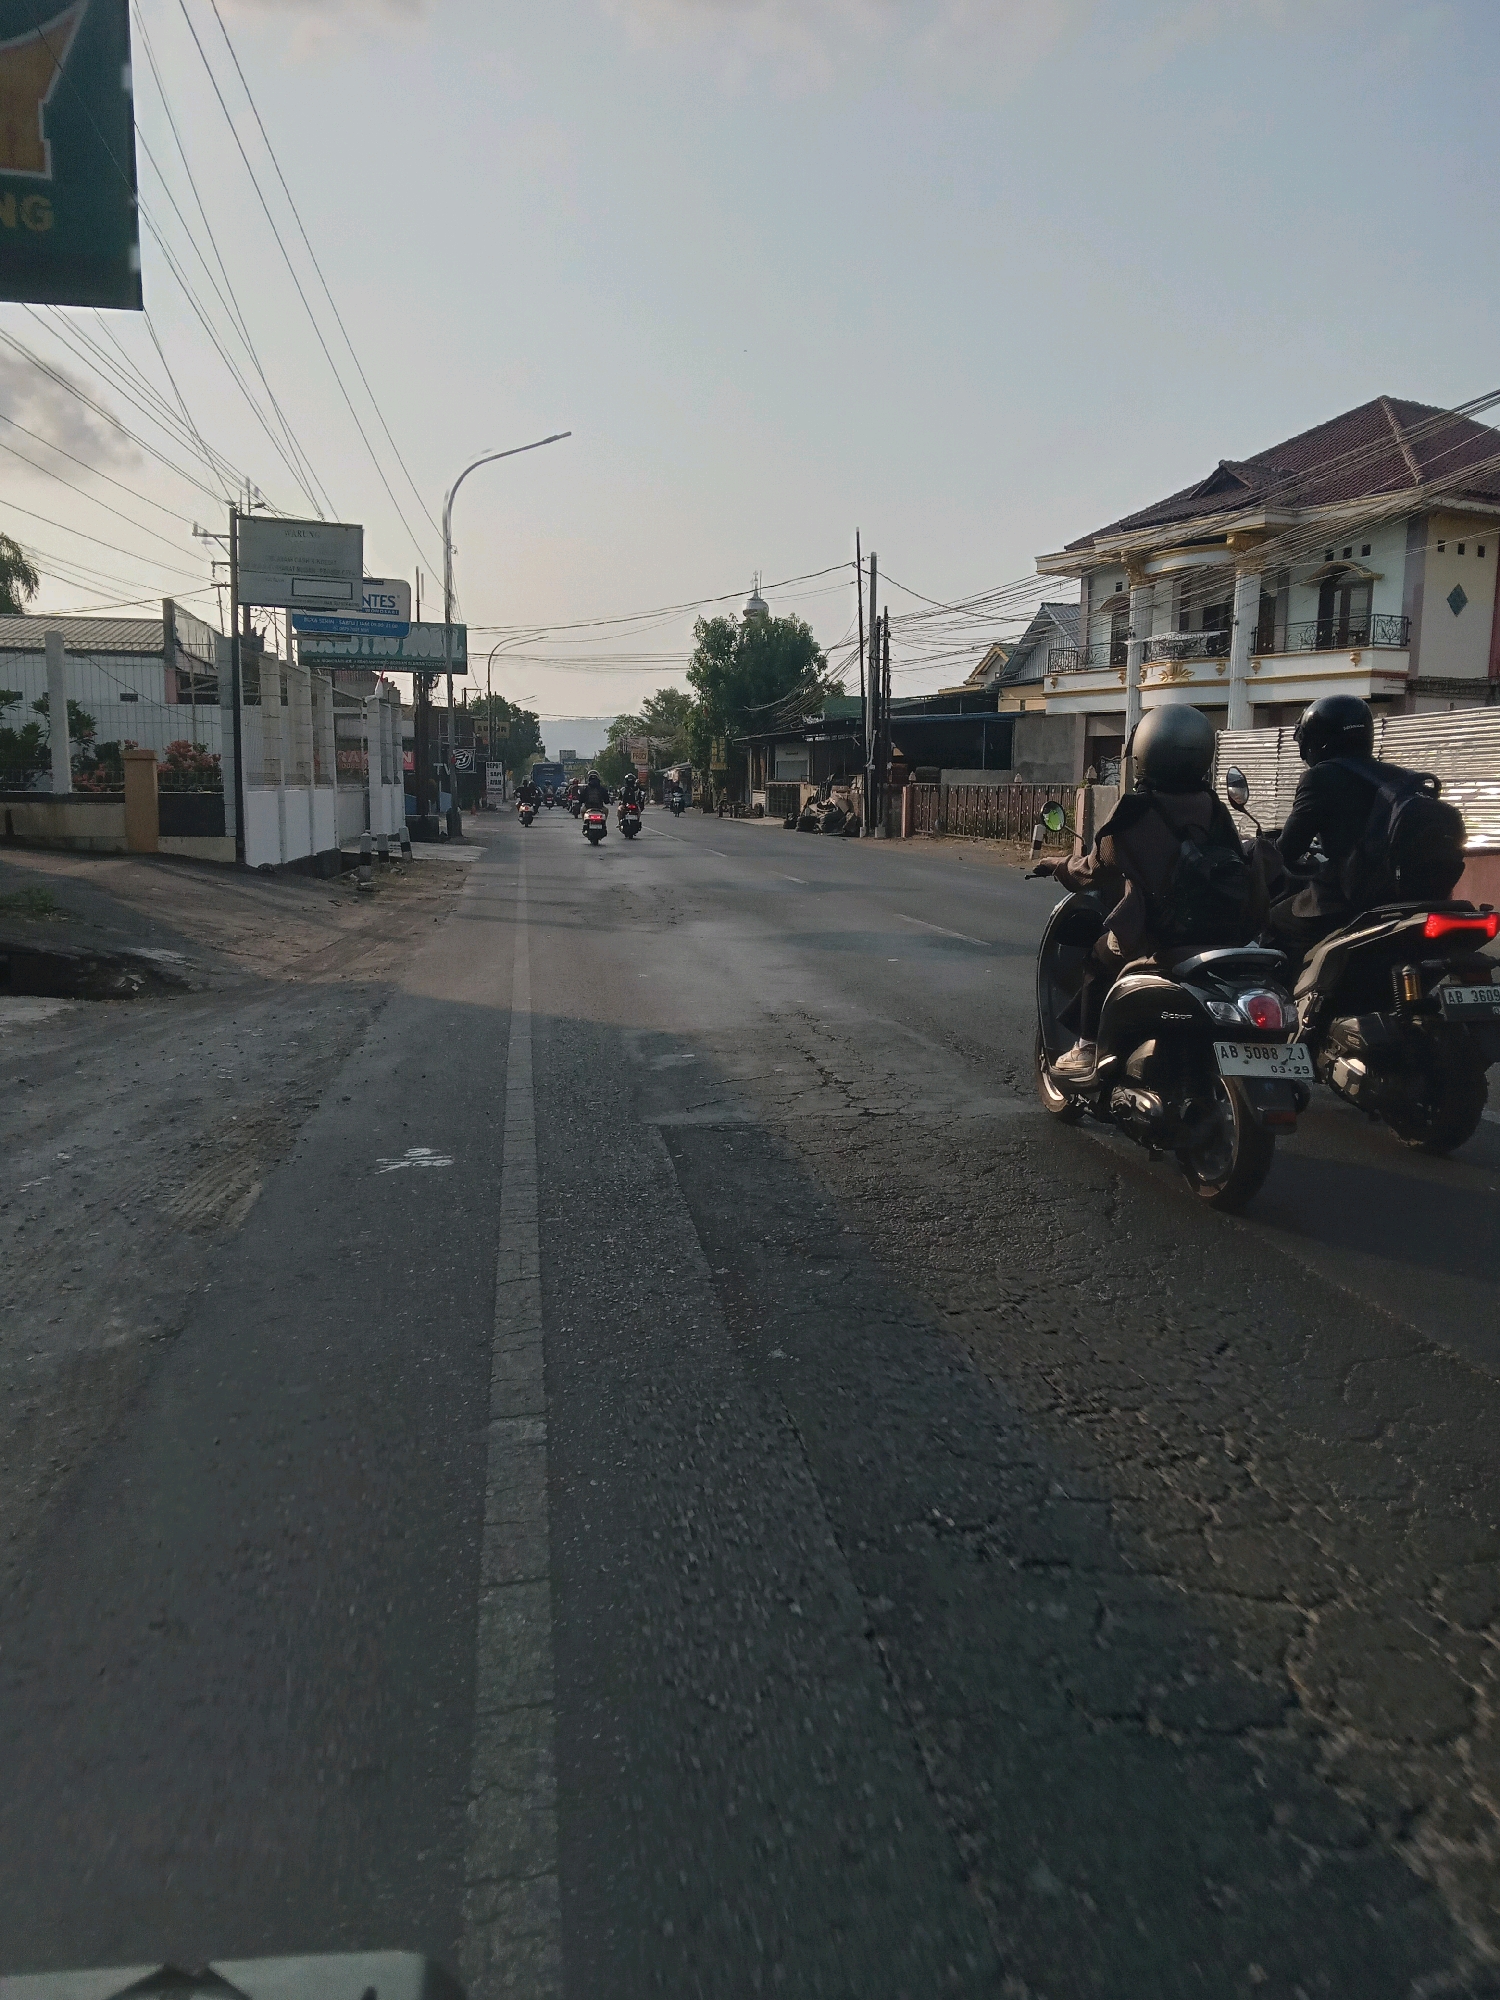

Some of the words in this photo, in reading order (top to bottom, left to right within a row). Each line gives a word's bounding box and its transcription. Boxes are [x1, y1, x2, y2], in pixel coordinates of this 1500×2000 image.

[284, 529, 321, 539] WARUNG
[1448, 990, 1463, 1003] AB
[1220, 1045, 1239, 1059] AB
[1243, 1046, 1279, 1060] 5088
[1286, 1047, 1305, 1061] ZJ
